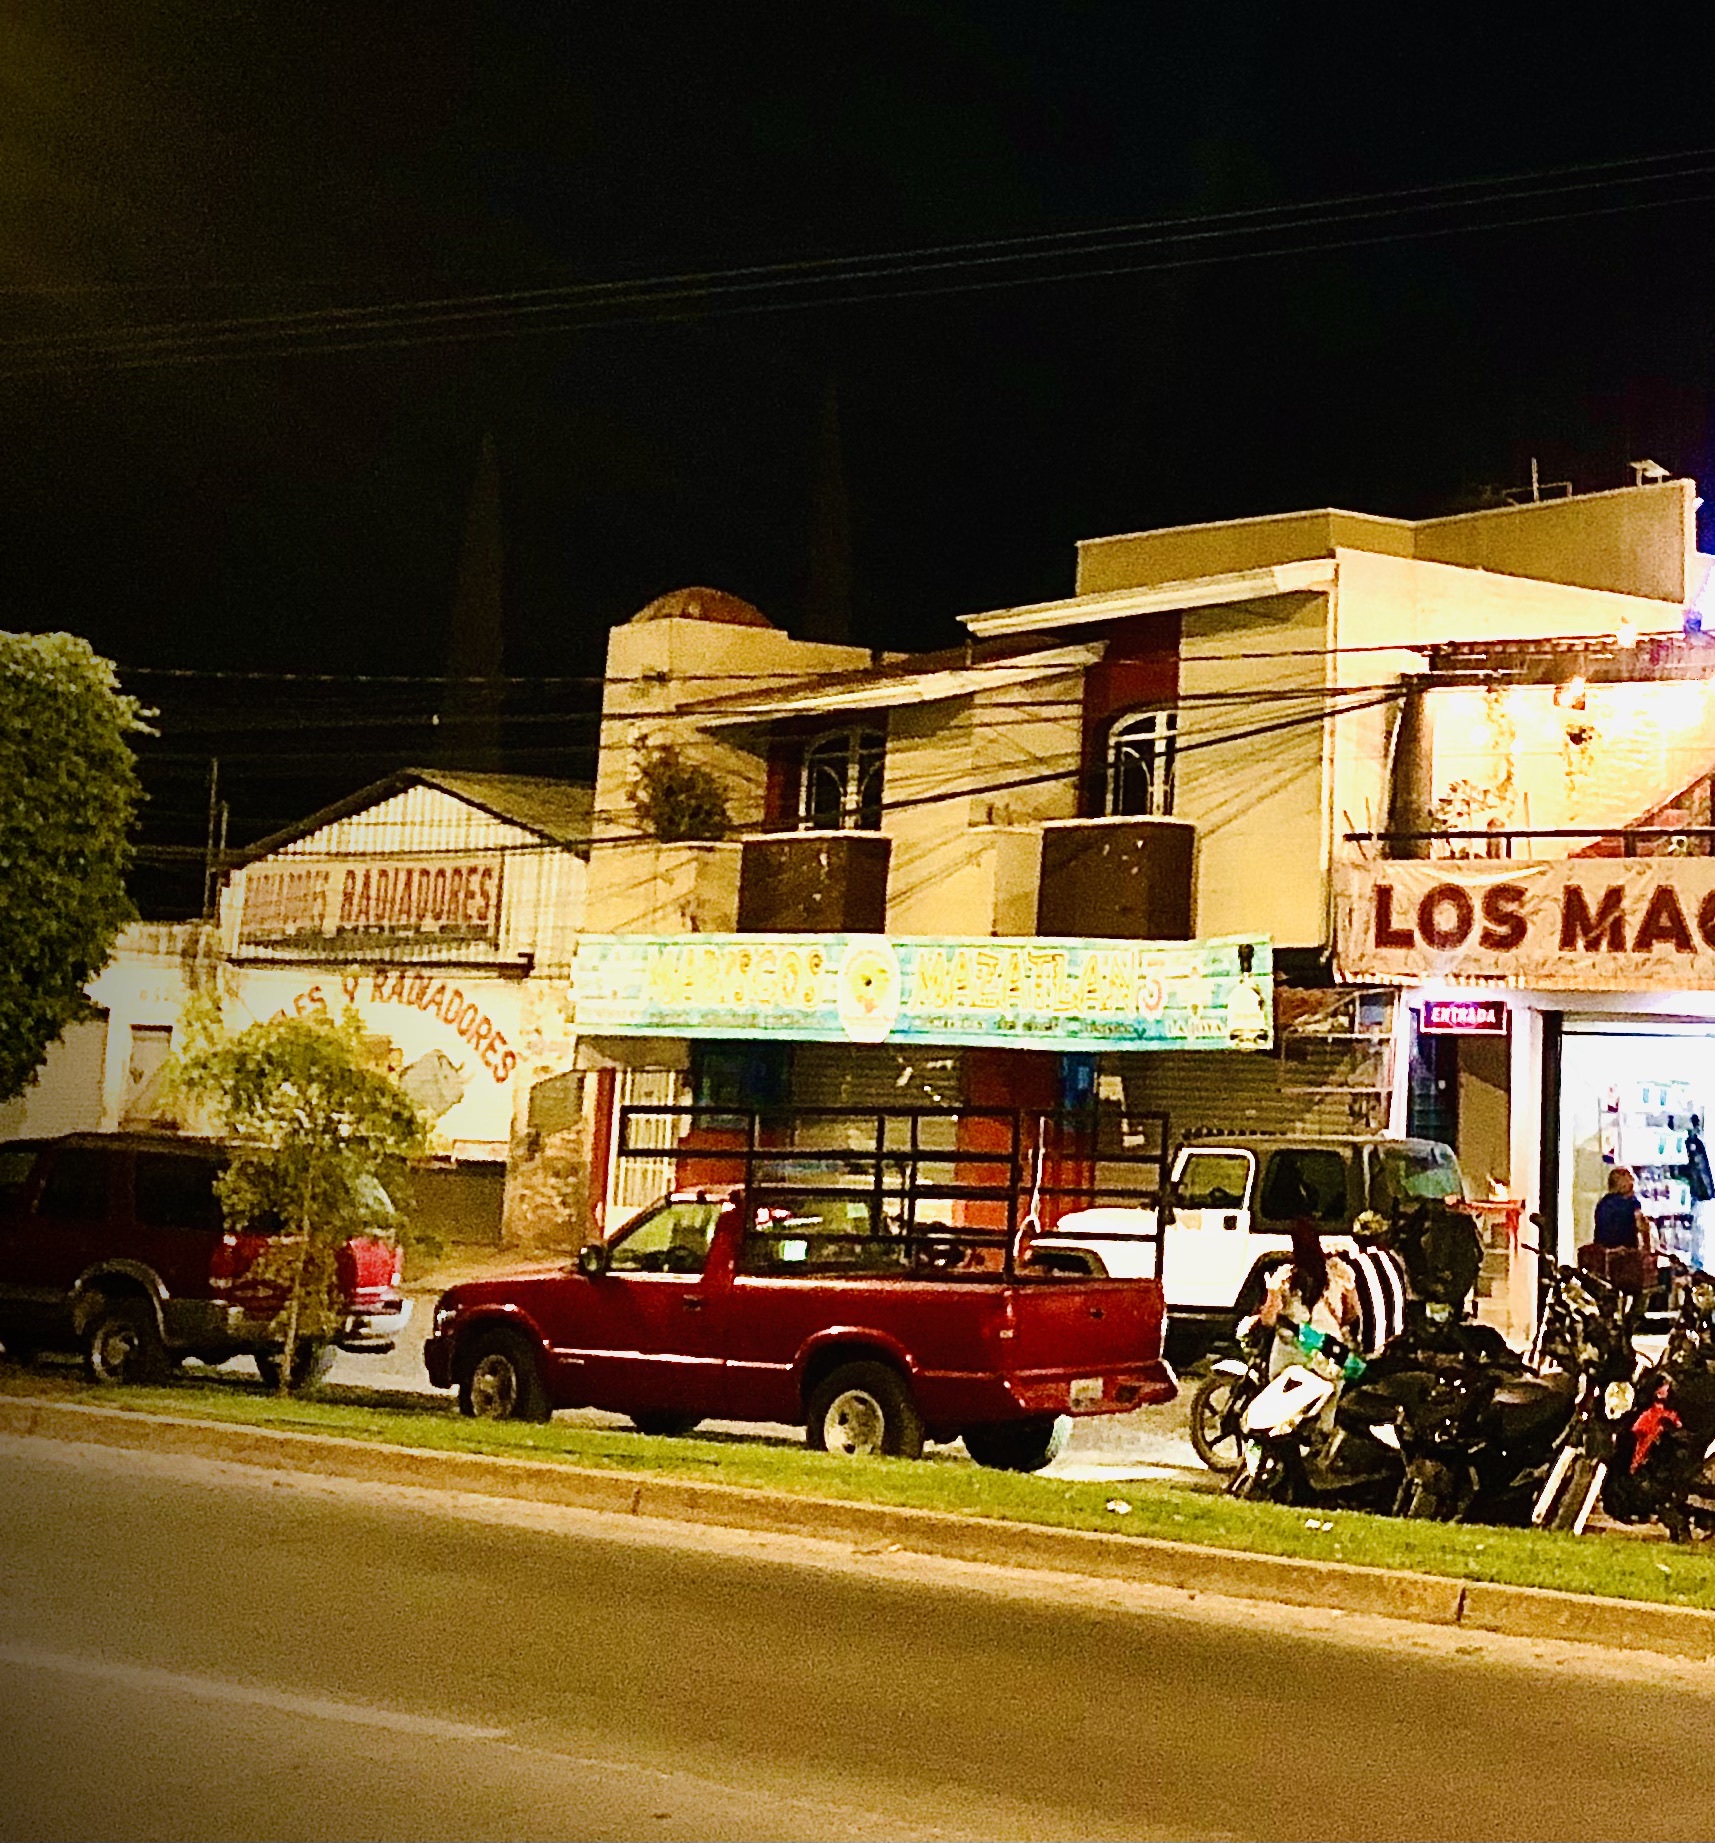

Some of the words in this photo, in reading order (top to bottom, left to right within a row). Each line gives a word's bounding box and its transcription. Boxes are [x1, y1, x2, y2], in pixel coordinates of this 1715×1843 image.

[340, 866, 493, 922] RADIADORES
[1373, 884, 1528, 951] LOS
[909, 948, 1136, 1014] MAZATLAN
[370, 971, 517, 1083] RADIADORES
[1430, 1006, 1497, 1024] ENTRADA
